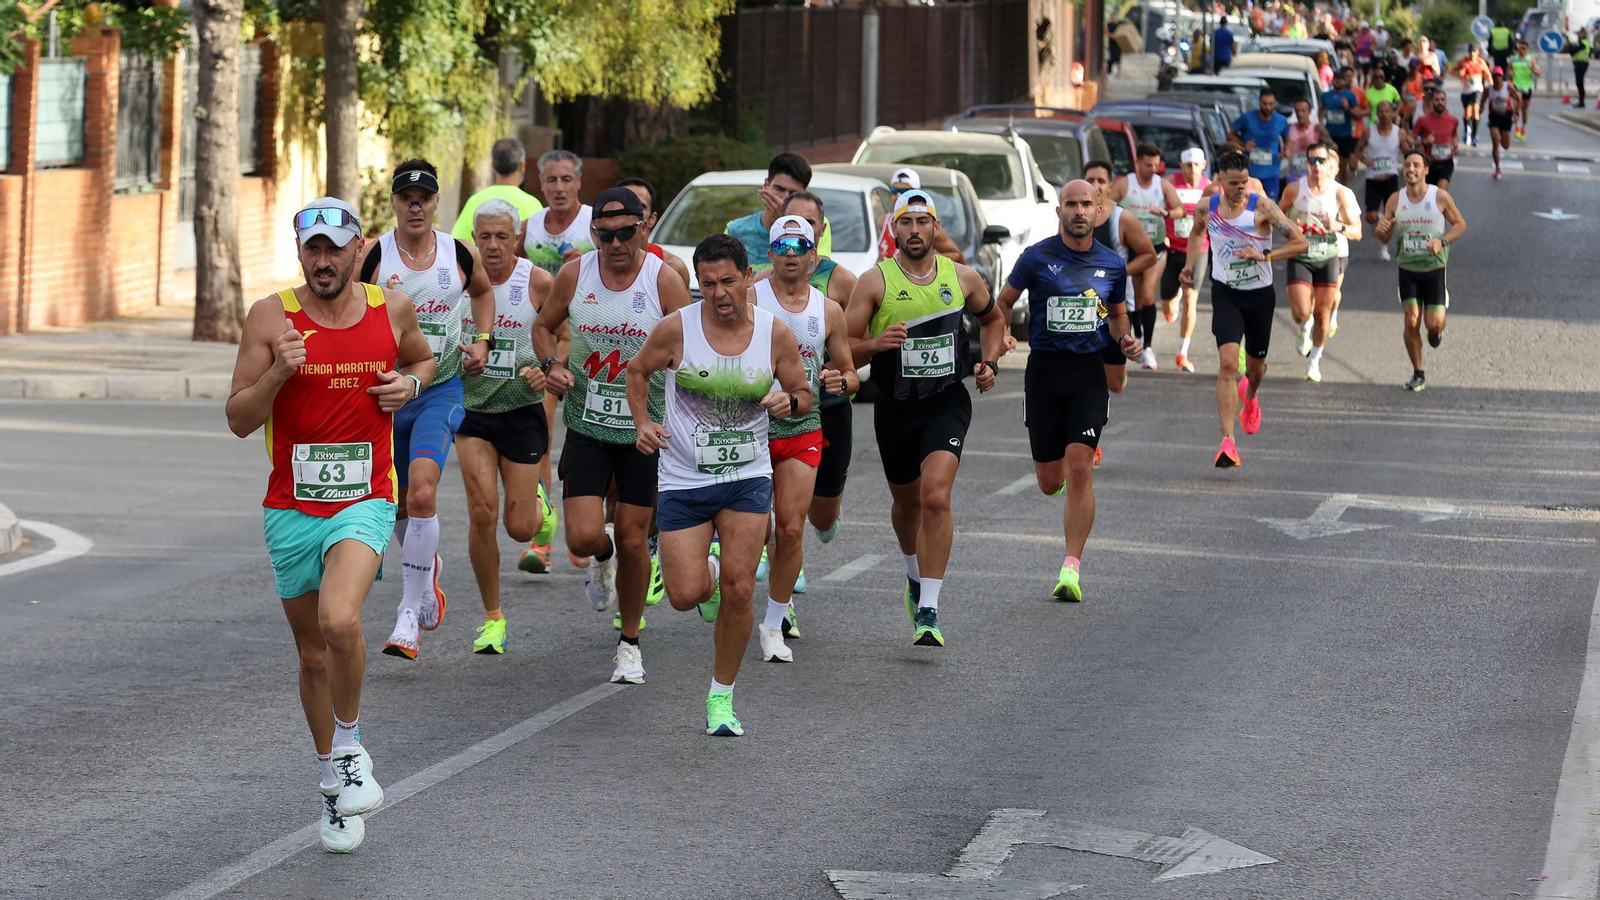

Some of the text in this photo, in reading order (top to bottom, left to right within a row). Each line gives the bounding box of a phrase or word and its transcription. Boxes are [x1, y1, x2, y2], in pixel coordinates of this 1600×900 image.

[1235, 268, 1249, 279] 24
[1059, 308, 1085, 321] 122
[578, 321, 649, 338] maratón
[920, 350, 940, 365] 96
[299, 361, 387, 375] TIENDA MARATHON
[327, 377, 359, 389] JEREZ
[602, 398, 622, 414] 81
[717, 446, 740, 462] 36
[318, 463, 346, 483] 63
